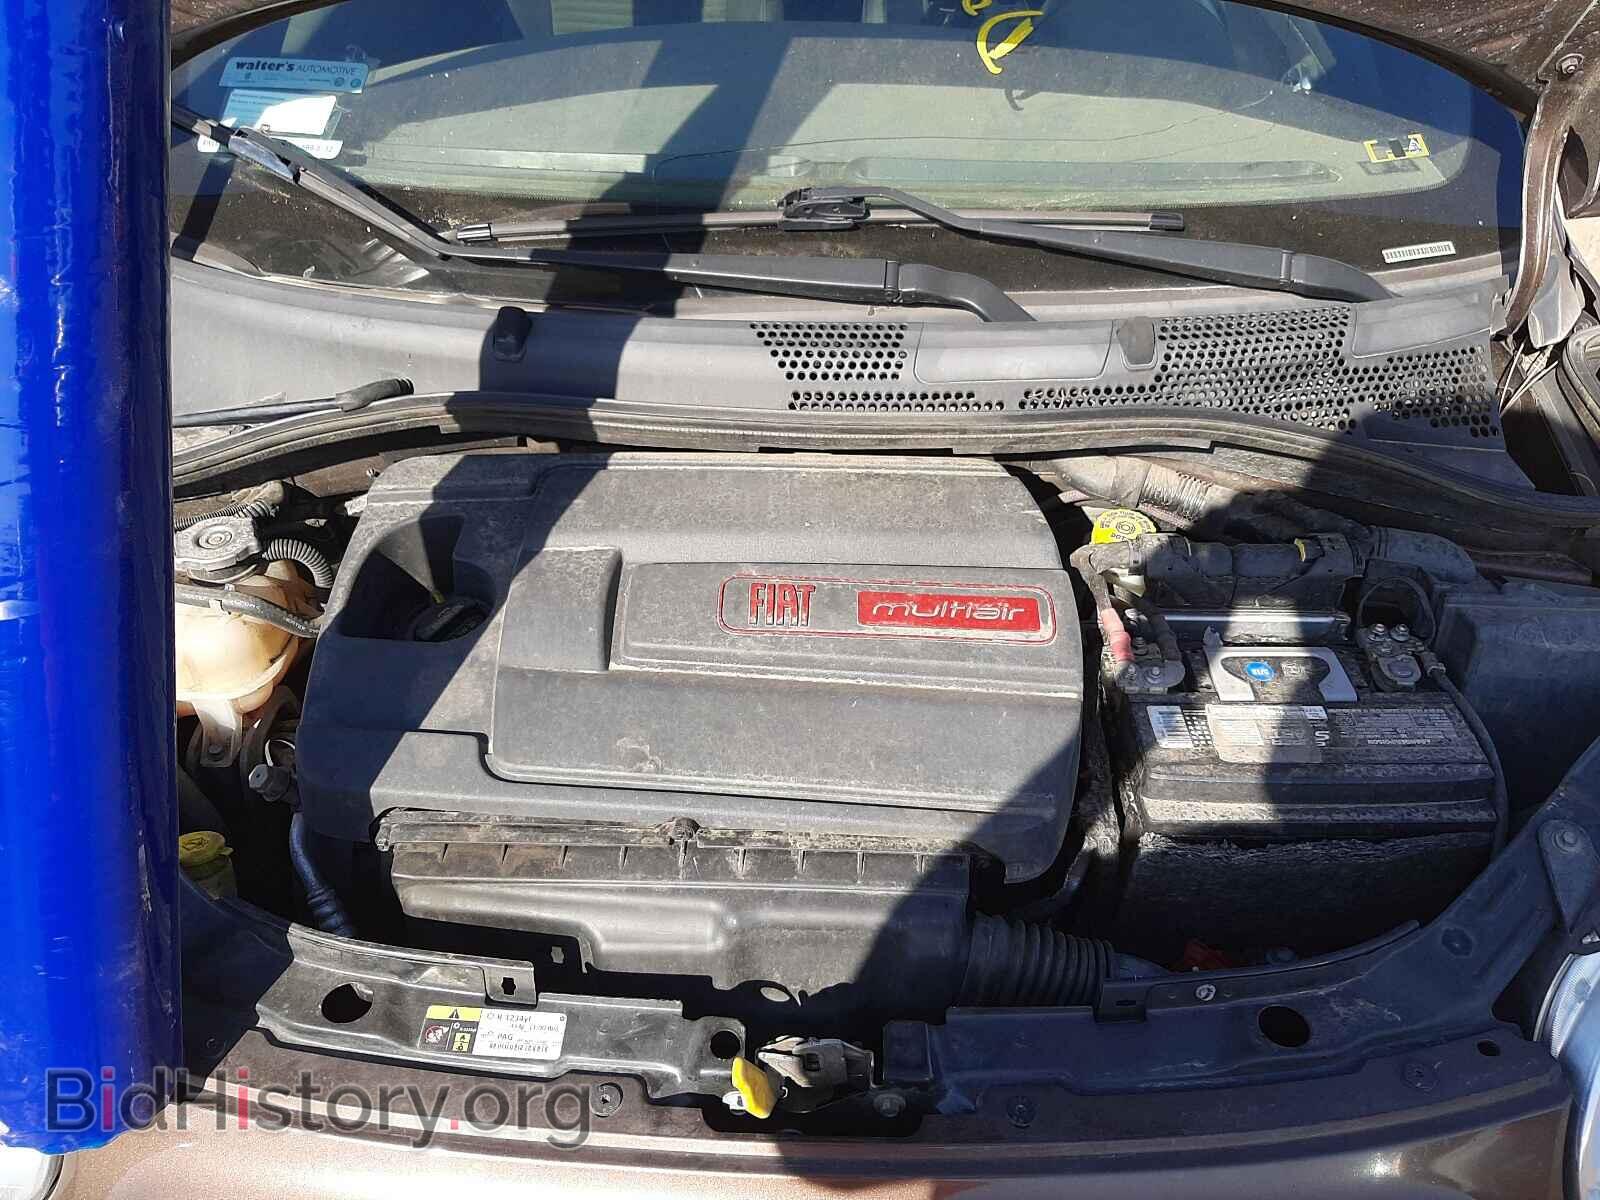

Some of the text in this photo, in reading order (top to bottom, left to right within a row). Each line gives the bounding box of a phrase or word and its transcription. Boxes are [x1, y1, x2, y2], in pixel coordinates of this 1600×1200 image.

[235, 60, 357, 76] walter's AUTOMOTIVE
[748, 583, 1025, 627] FIAT multiair
